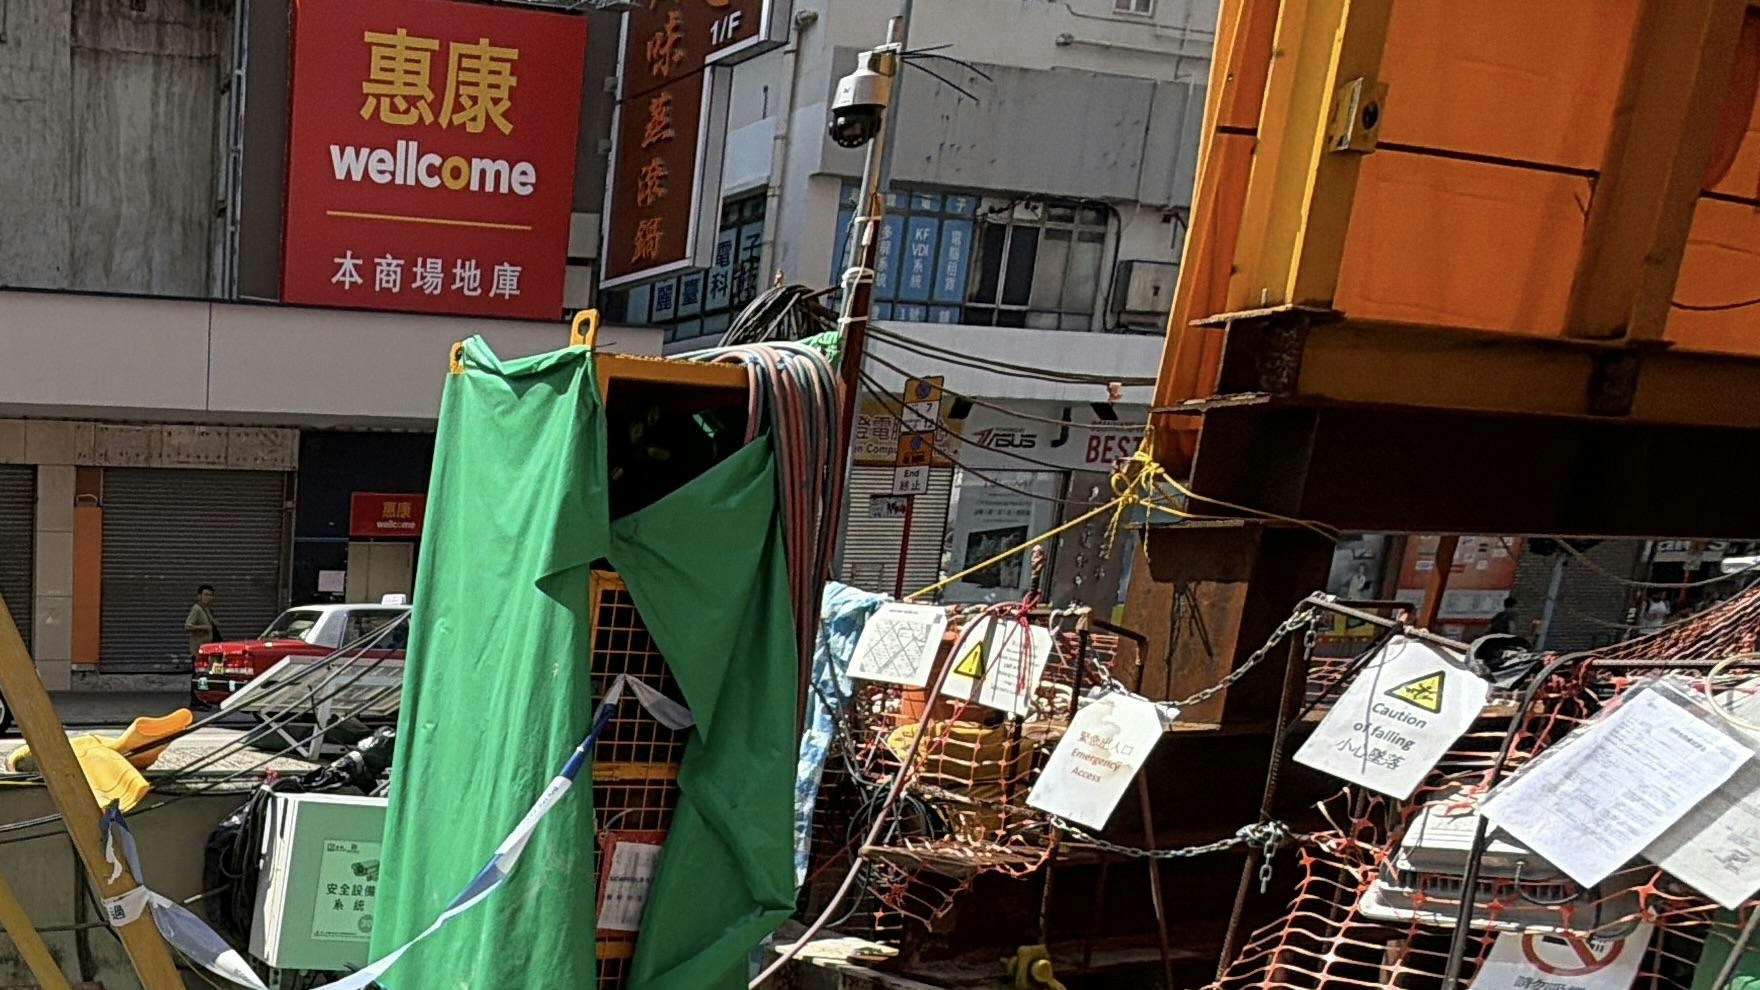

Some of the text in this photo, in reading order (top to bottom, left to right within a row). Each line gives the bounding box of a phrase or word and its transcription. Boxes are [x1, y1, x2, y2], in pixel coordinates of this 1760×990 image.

[710, 11, 742, 45] 1/F
[361, 27, 519, 136] 惠康
[329, 140, 537, 196] wellcome
[912, 243, 930, 257] VDI
[331, 250, 523, 299] 本商場地庫
[904, 469, 920, 478] End
[382, 501, 412, 518] 惠康
[376, 520, 416, 530] wellcome
[1372, 702, 1427, 729] Caution
[1353, 721, 1415, 751] of falling
[1071, 748, 1120, 772] Emergency
[1337, 738, 1405, 770] 小心墜落
[1071, 767, 1101, 783] Access
[326, 883, 376, 897] 安全設備
[332, 899, 365, 911] 系統
